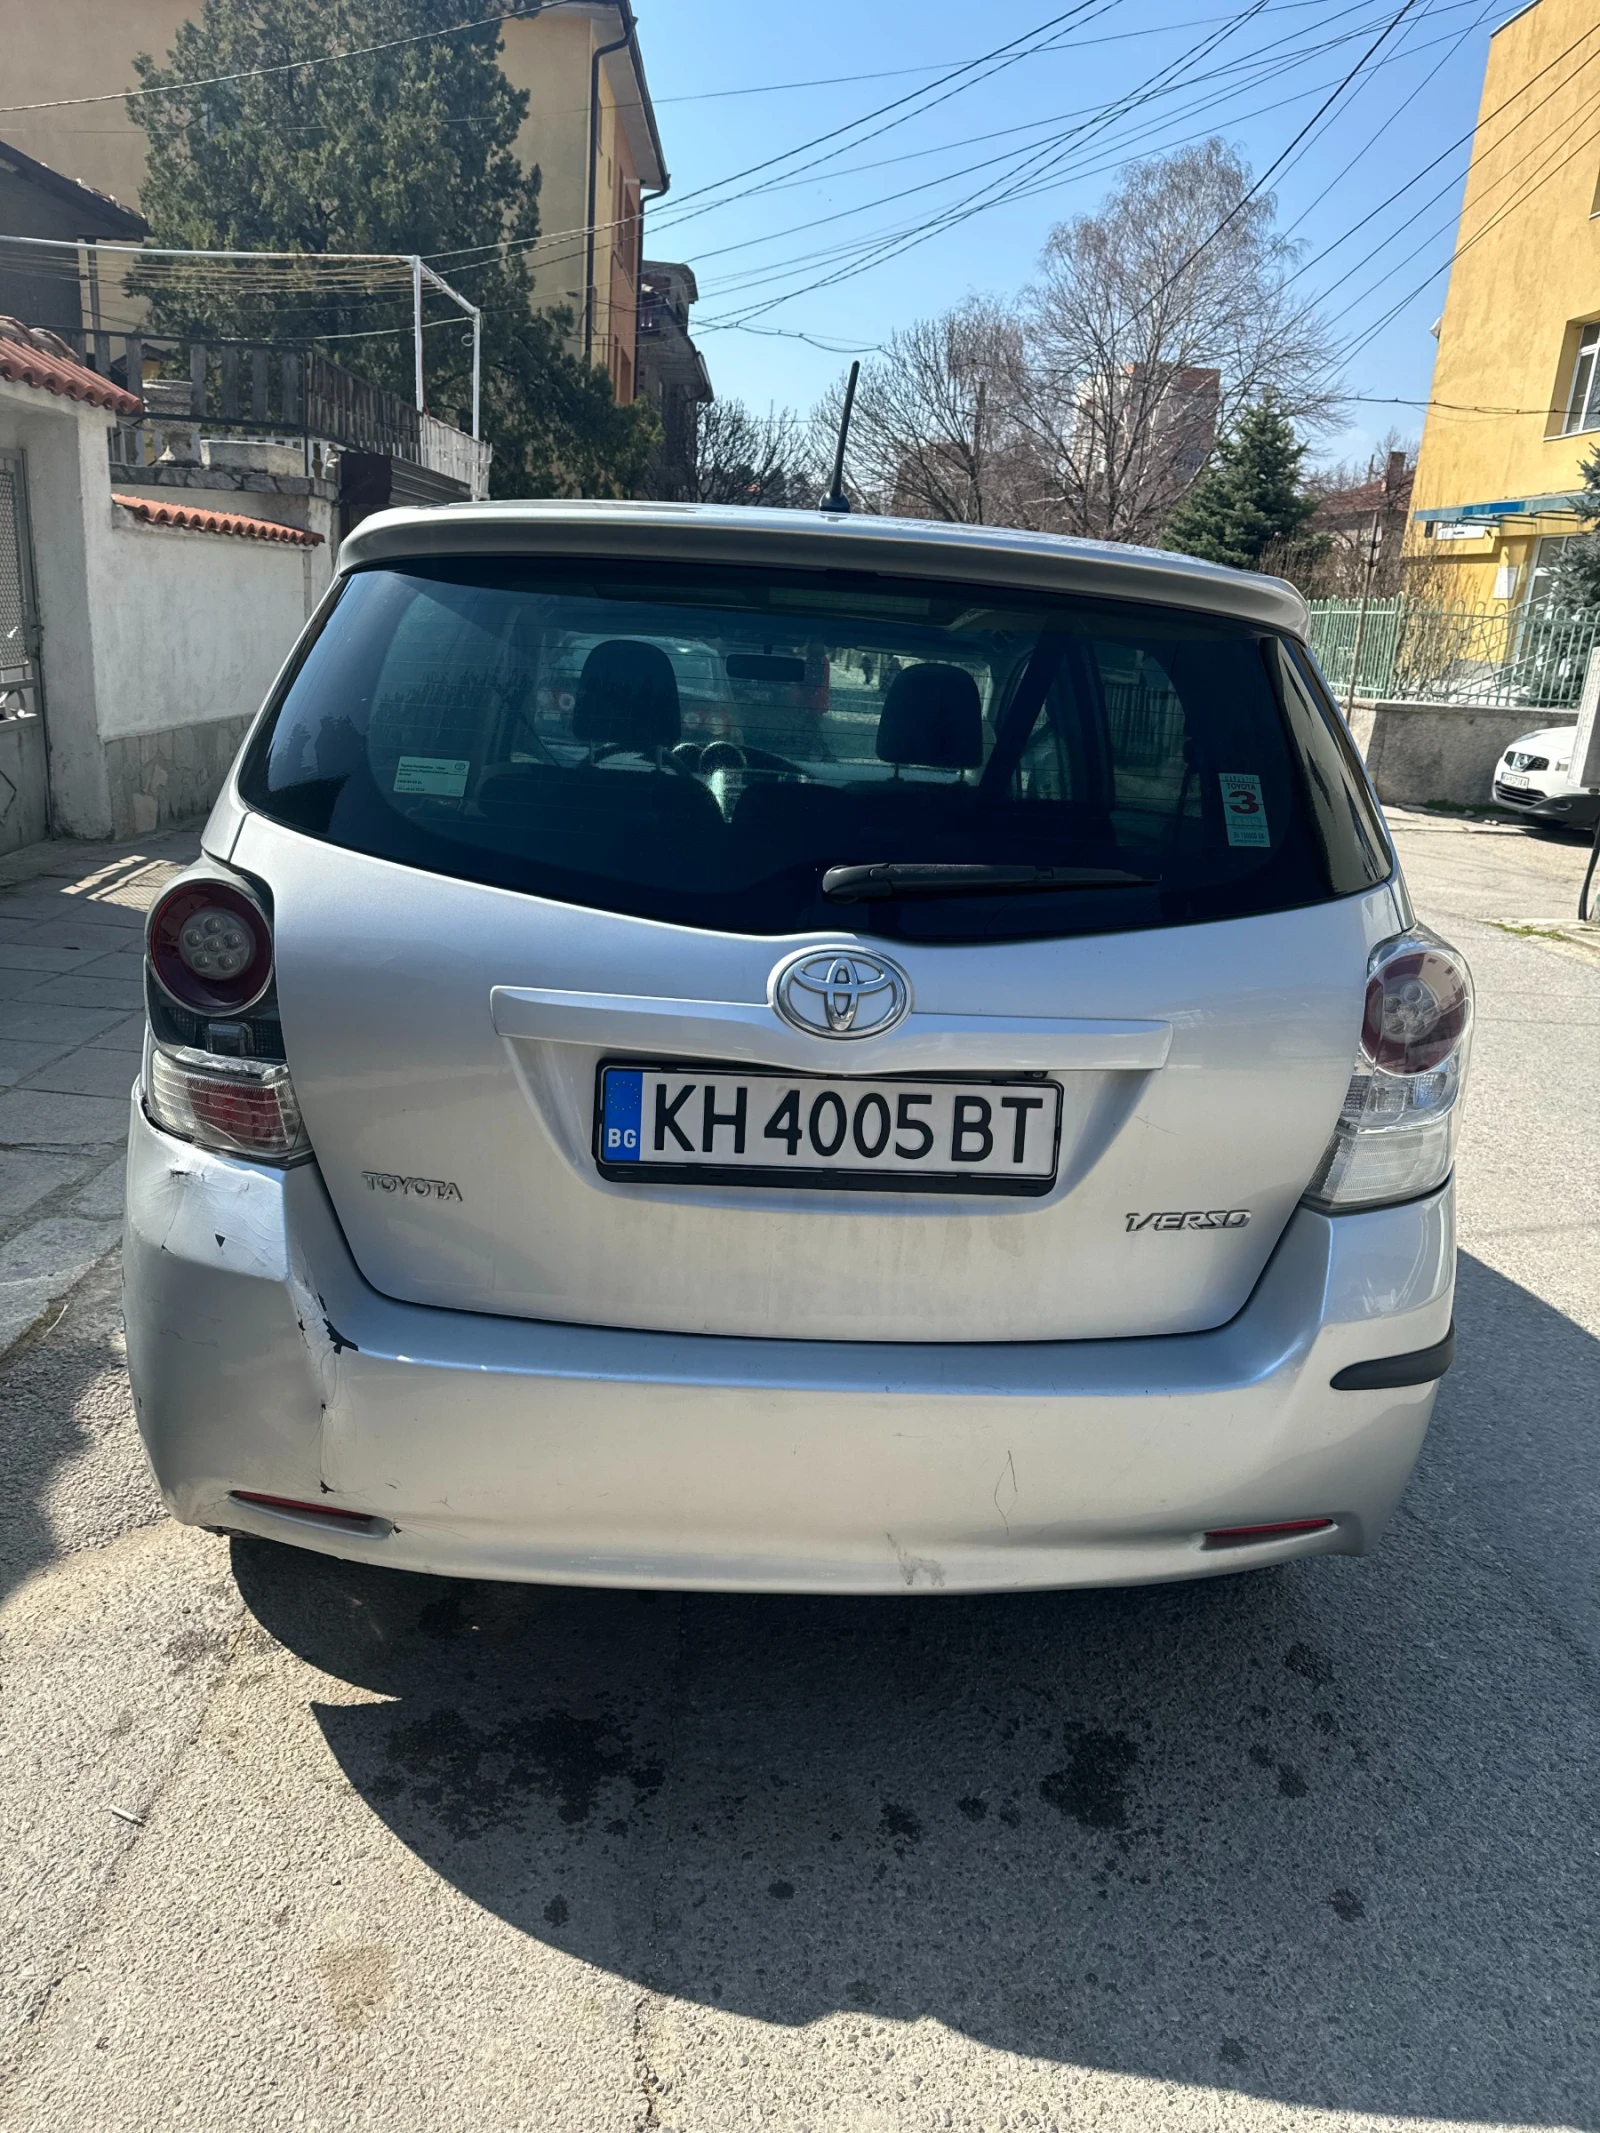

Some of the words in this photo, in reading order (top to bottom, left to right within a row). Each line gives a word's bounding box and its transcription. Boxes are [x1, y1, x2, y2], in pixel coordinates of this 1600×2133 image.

[1226, 783, 1257, 791] TOYOTA
[1229, 791, 1260, 814] 3
[653, 1083, 748, 1154] KH
[764, 1090, 934, 1159] 4005
[951, 1095, 1044, 1163] BT
[607, 1128, 637, 1149] BG
[362, 1171, 463, 1202] TOYOTA
[1126, 1209, 1252, 1232] VERSO
